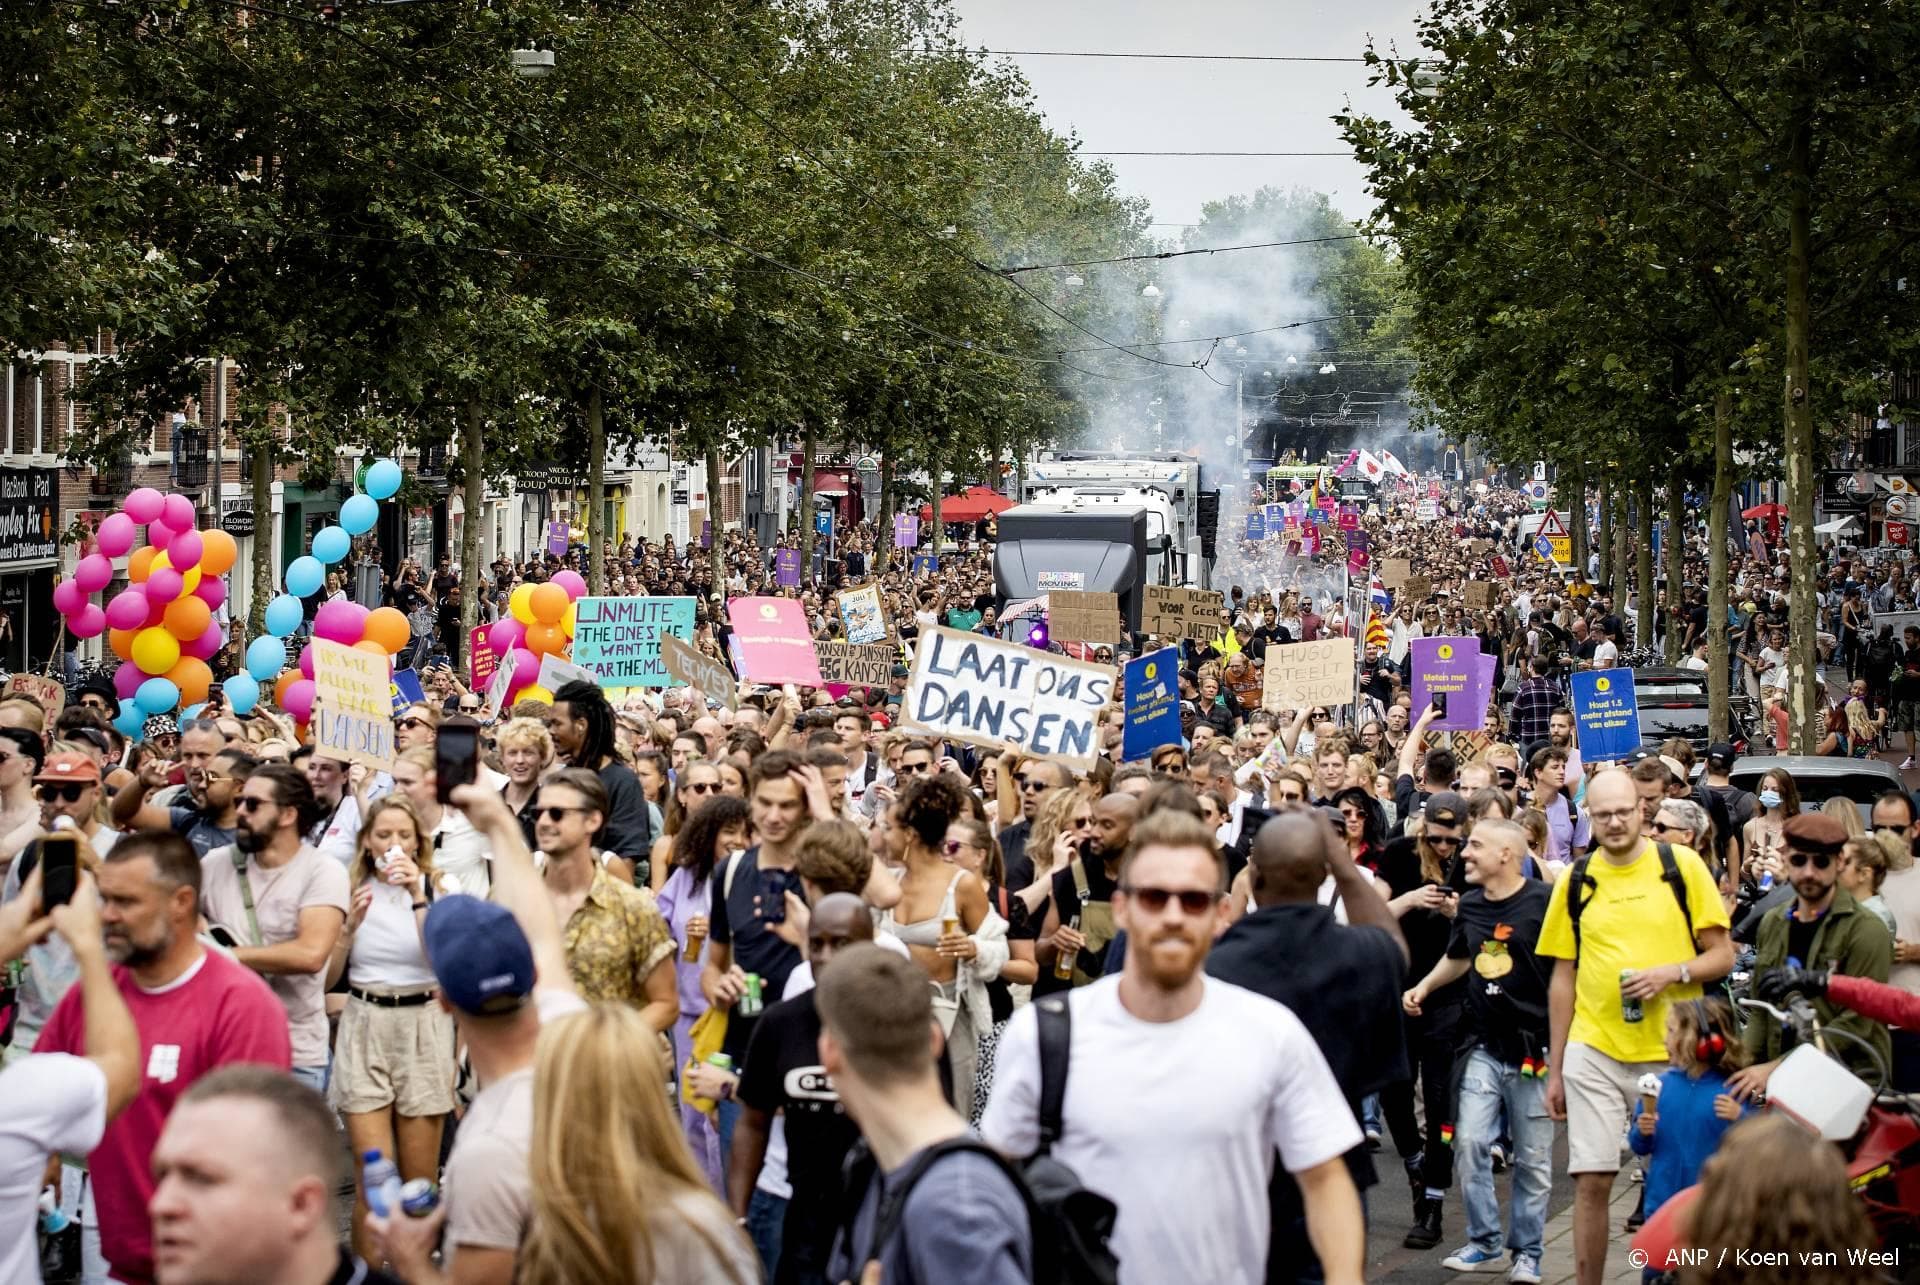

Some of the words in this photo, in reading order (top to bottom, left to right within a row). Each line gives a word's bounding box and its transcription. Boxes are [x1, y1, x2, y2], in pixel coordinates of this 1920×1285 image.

[34, 474, 50, 497] iPad
[516, 480, 547, 490] GOUD
[820, 518, 827, 528] P
[1150, 588, 1172, 599] DIT
[576, 601, 674, 624] UNMUTE
[580, 626, 610, 642] THE
[614, 626, 654, 641] ONES
[1151, 616, 1183, 638] 1.5
[601, 642, 641, 657] WANT
[1281, 645, 1333, 664] HUGO
[618, 659, 642, 676] THE
[929, 634, 1030, 690] LAAT
[845, 660, 892, 685] KANSEN
[1268, 662, 1343, 684] STEELT
[1295, 680, 1347, 702] SHOW
[1426, 684, 1433, 692] 2
[1588, 701, 1609, 710] Houd
[1611, 699, 1623, 707] 1.5
[917, 682, 1091, 755] DANSEN
[1588, 721, 1602, 729] van
[1485, 983, 1502, 995] Jr.
